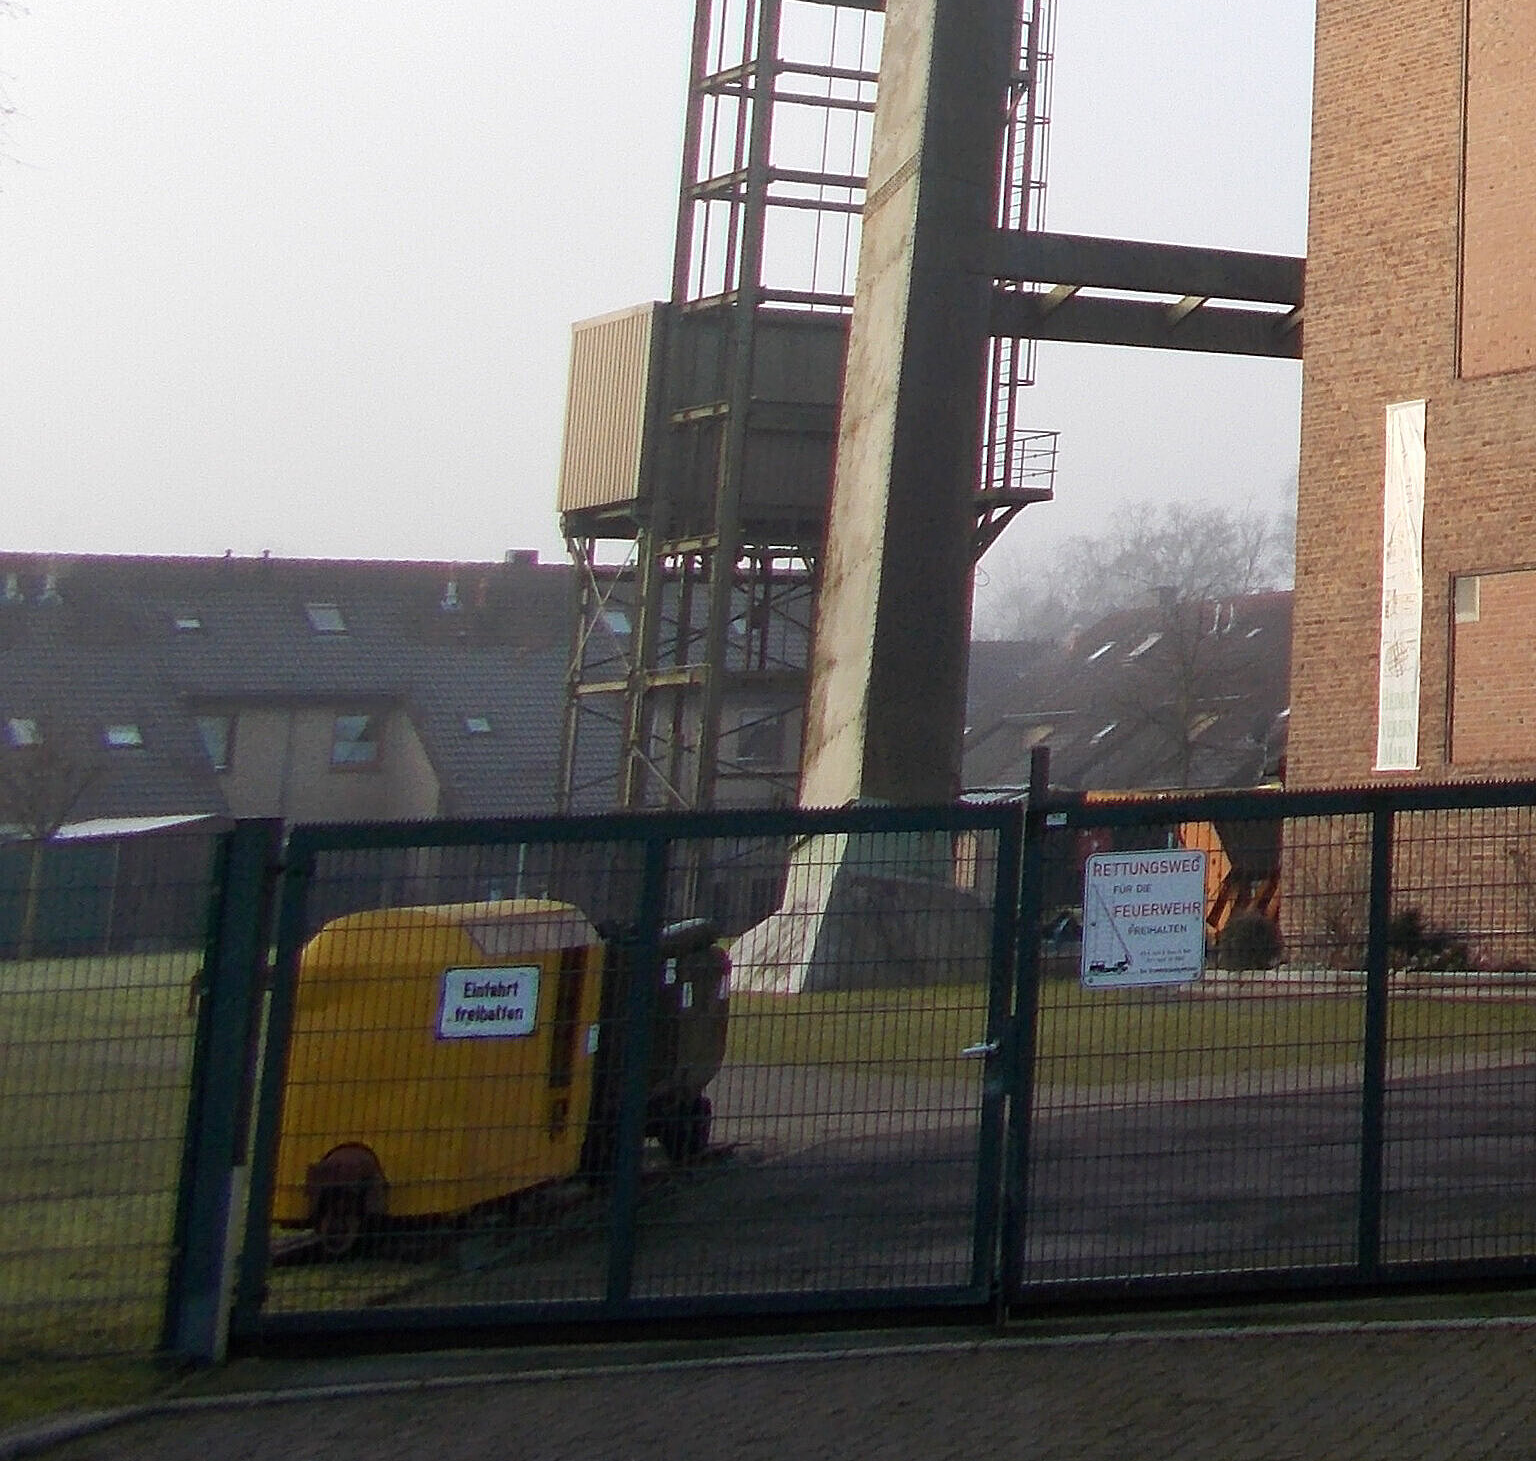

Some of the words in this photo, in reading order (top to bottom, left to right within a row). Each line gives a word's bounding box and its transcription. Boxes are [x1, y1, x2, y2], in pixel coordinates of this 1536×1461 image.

[1092, 858, 1200, 877] RETTUNGSWEG
[1136, 883, 1152, 893] DIE
[1113, 901, 1201, 918] FEUERWEHR
[1128, 924, 1187, 935] FREIHALTEN
[463, 981, 519, 999] Einfahrt
[455, 1004, 525, 1022] freihalten
